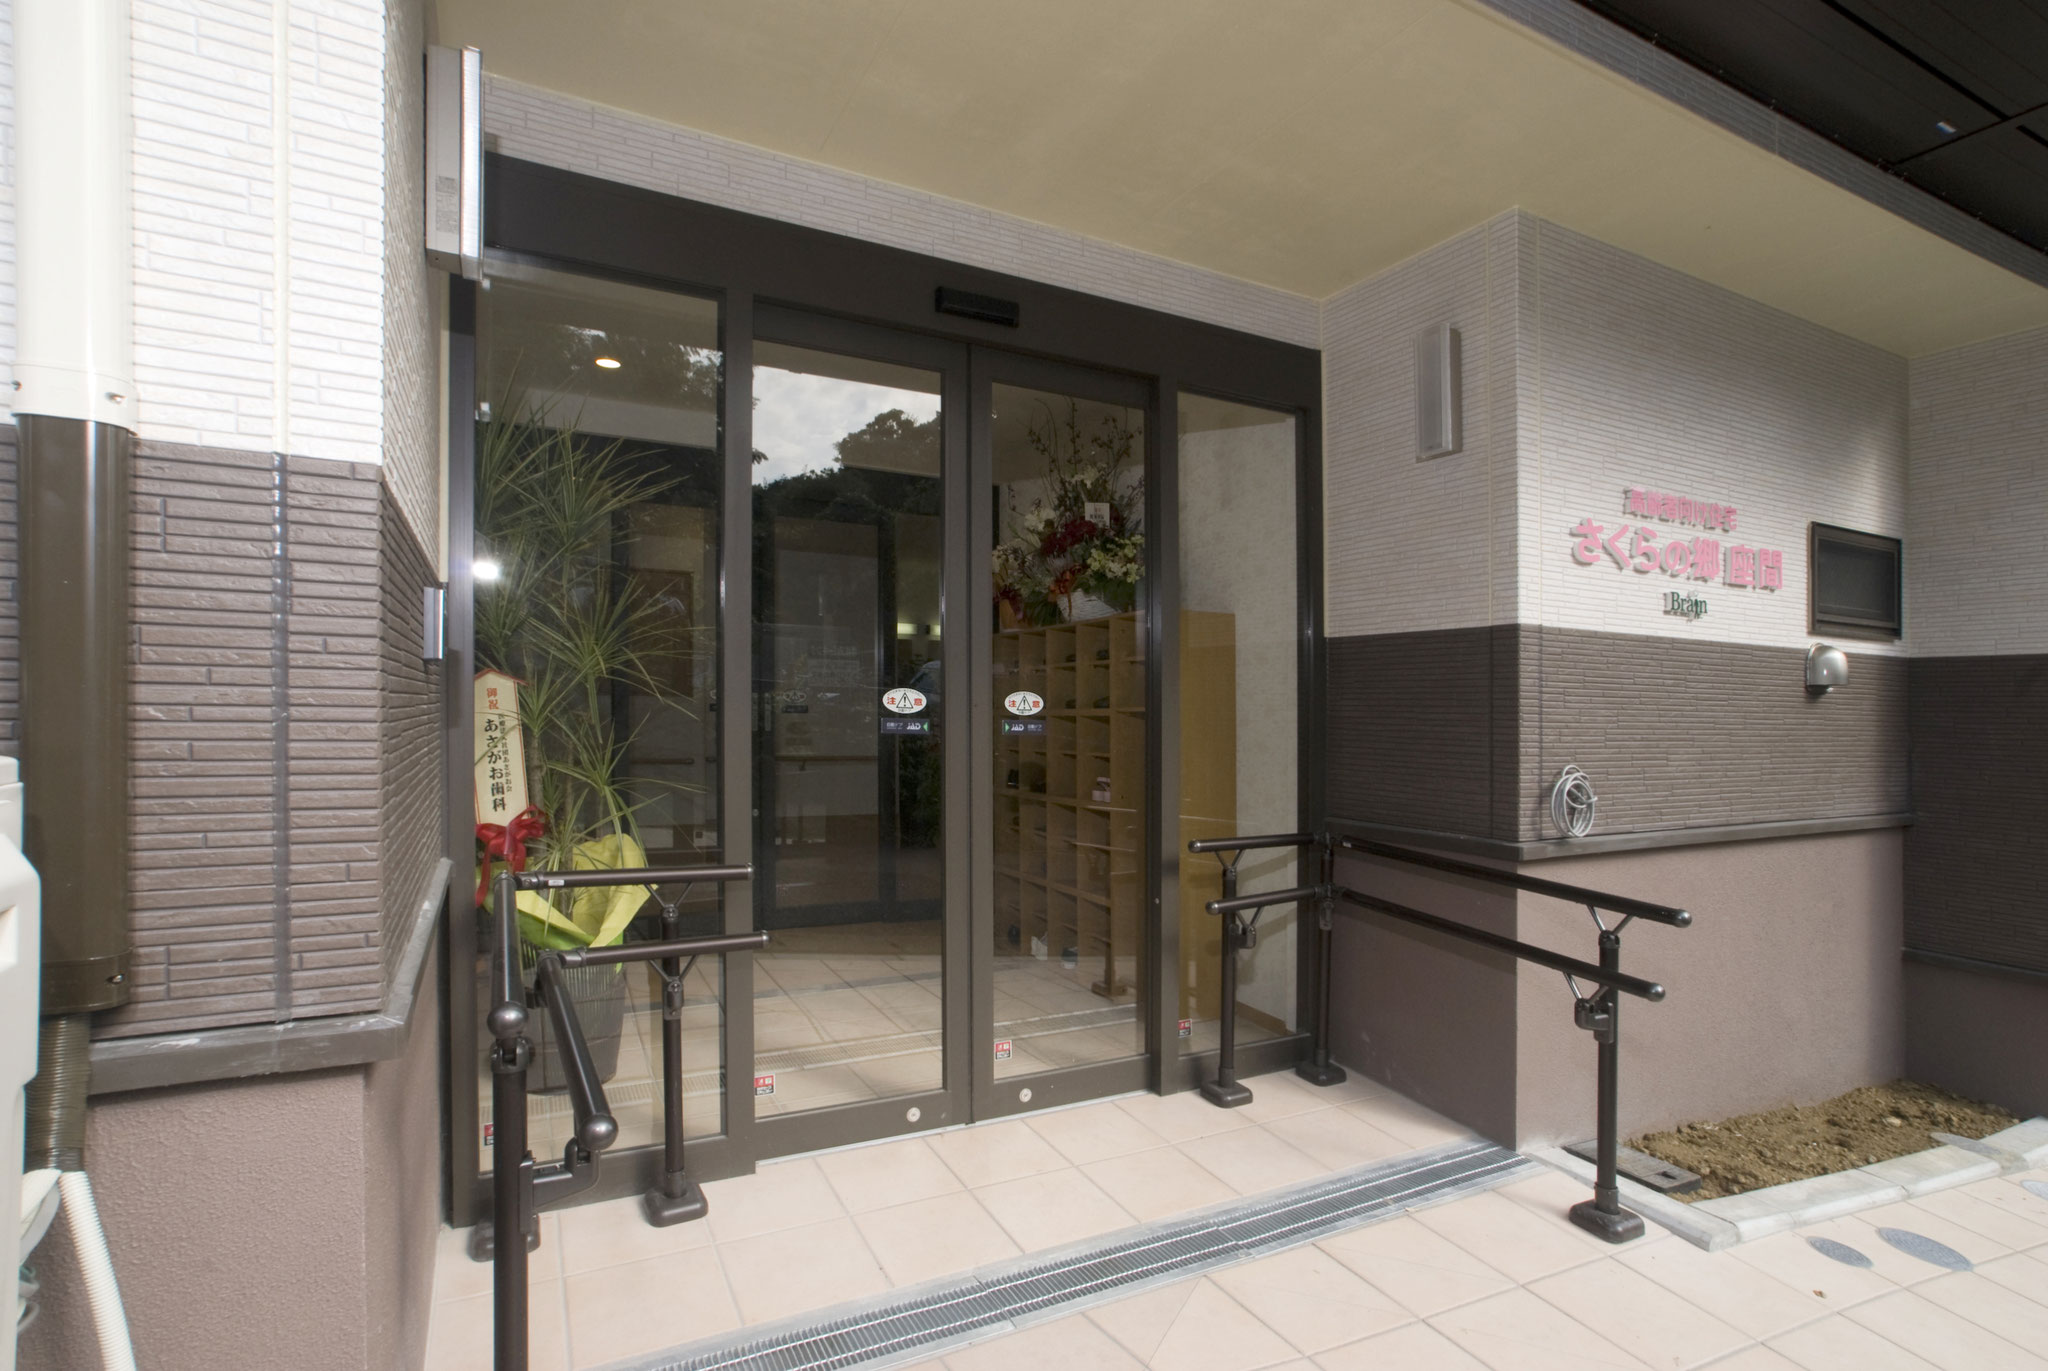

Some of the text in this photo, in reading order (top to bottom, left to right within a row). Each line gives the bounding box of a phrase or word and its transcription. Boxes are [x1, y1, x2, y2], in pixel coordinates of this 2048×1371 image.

[1630, 487, 1737, 530] 高齢者向け住宅
[1576, 518, 1783, 589] さくらの郷 座間
[1670, 592, 1708, 616] Brain
[486, 687, 499, 710] 御祝
[484, 719, 507, 812] あさがお歯科
